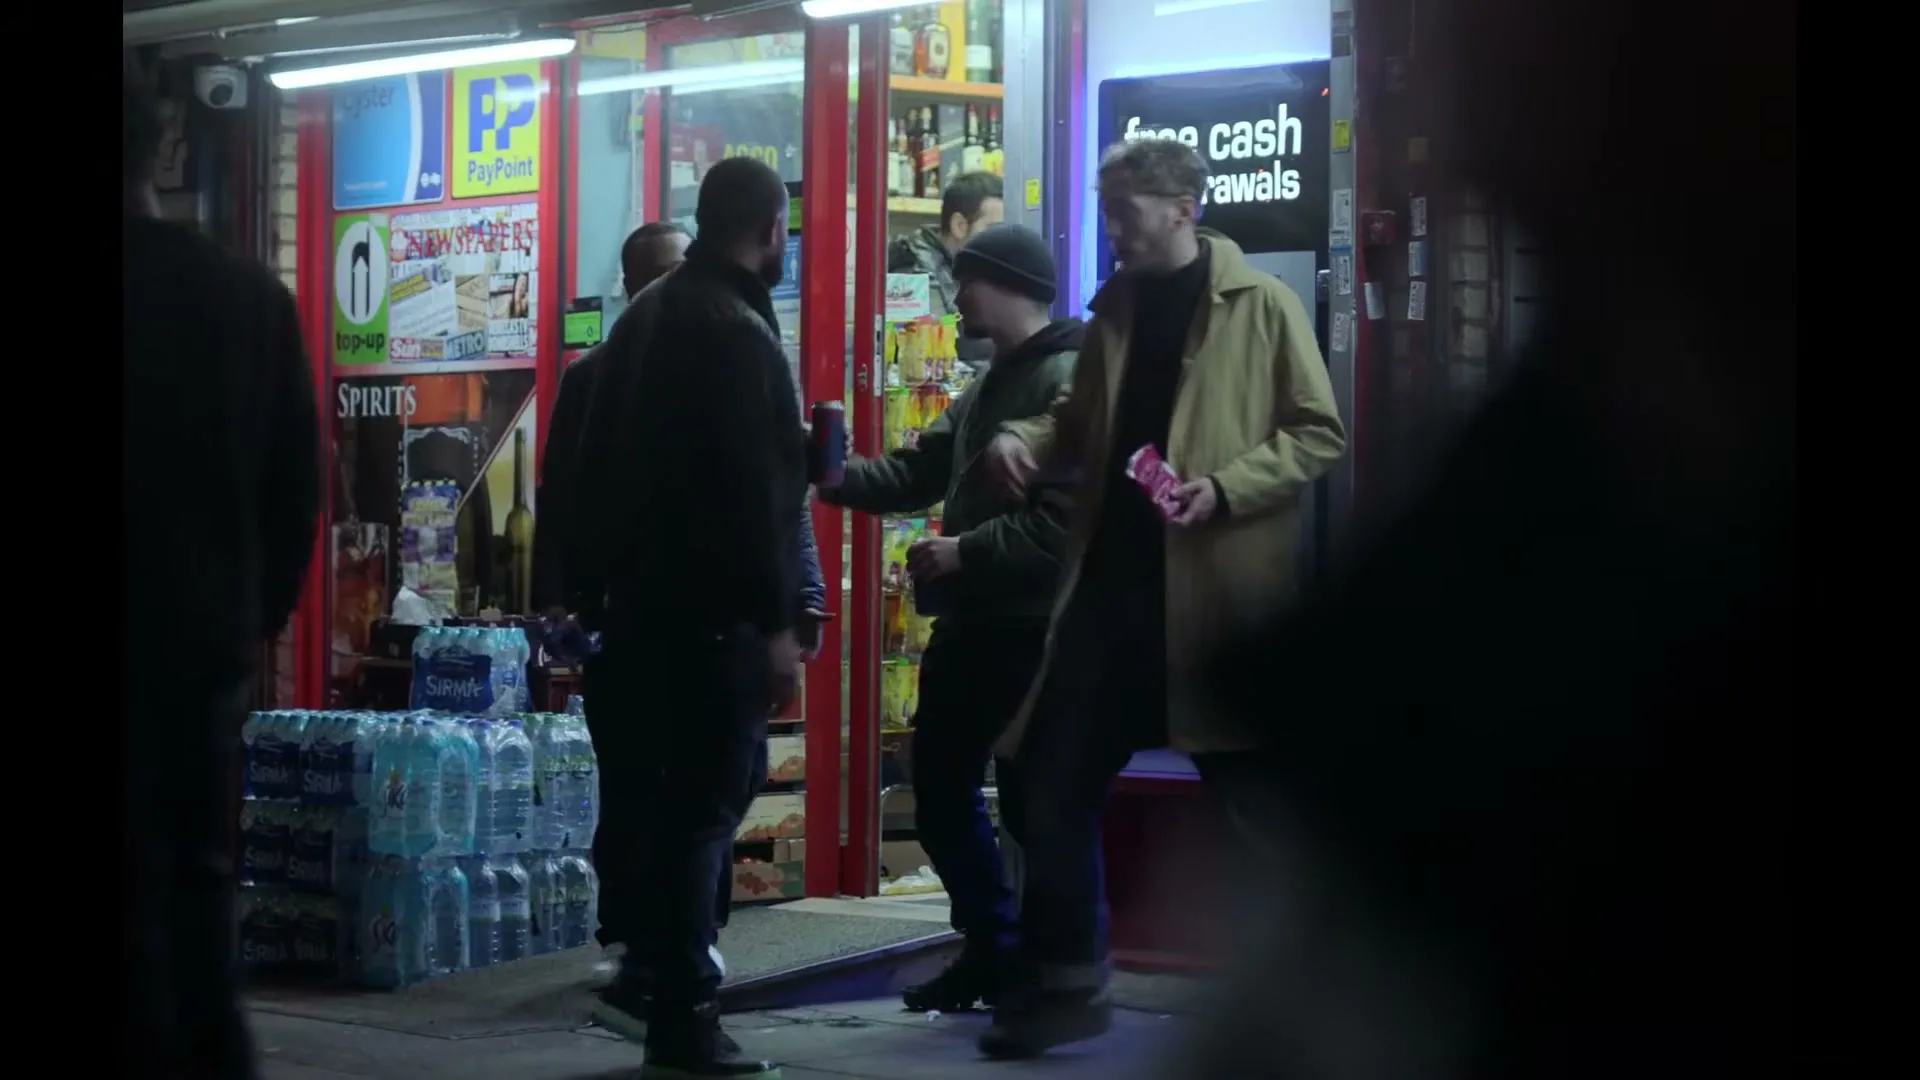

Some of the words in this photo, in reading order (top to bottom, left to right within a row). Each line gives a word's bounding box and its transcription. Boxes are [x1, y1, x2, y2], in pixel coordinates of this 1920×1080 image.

[1209, 103, 1302, 160] cash
[468, 156, 533, 186] PayPoint
[1200, 160, 1301, 205] rawals
[406, 219, 535, 257] NEWSPAPERS
[336, 331, 385, 355] top-up
[337, 382, 418, 419] SPIRITS
